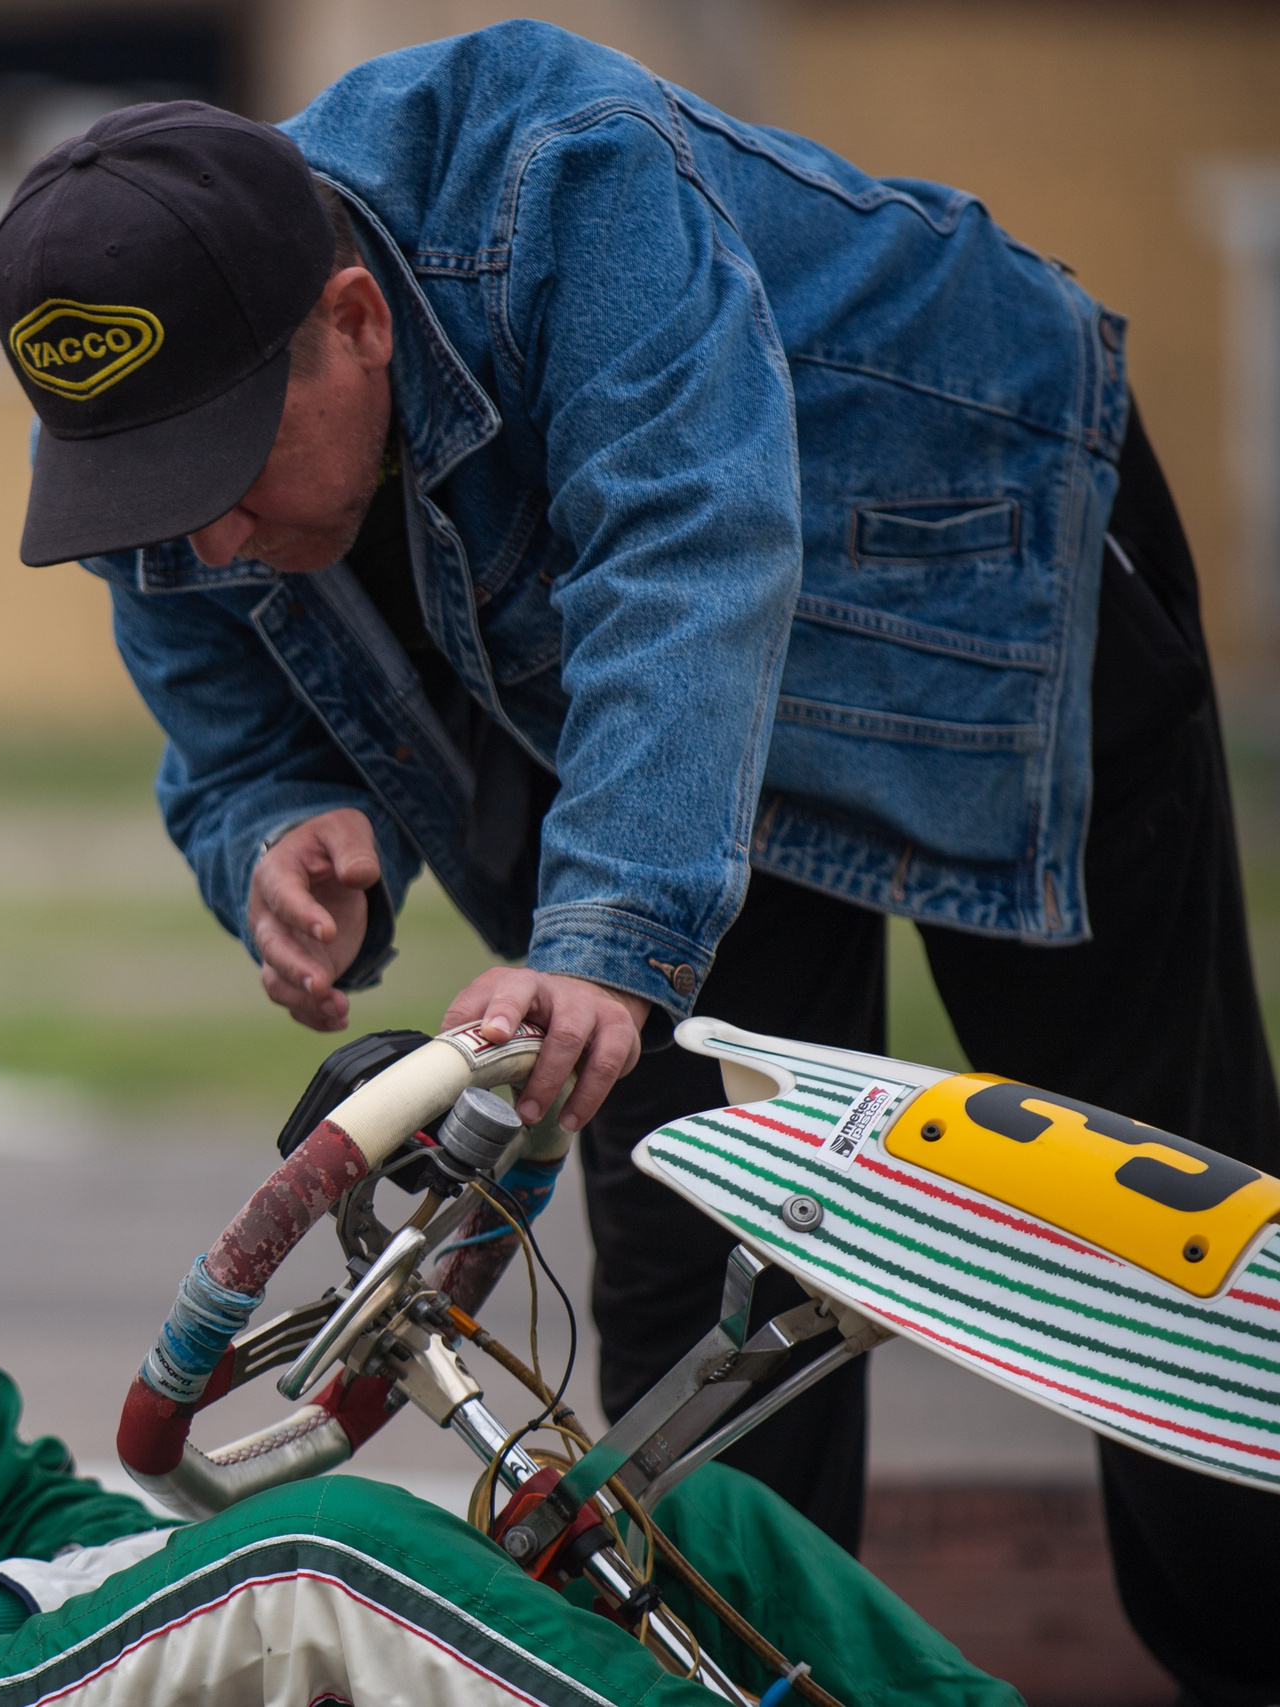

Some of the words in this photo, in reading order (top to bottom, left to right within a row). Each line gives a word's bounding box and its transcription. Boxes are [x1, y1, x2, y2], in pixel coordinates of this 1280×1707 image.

[24, 327, 132, 369] YACCO
[850, 1094, 889, 1140] piston
[964, 1082, 1262, 1212] 3
